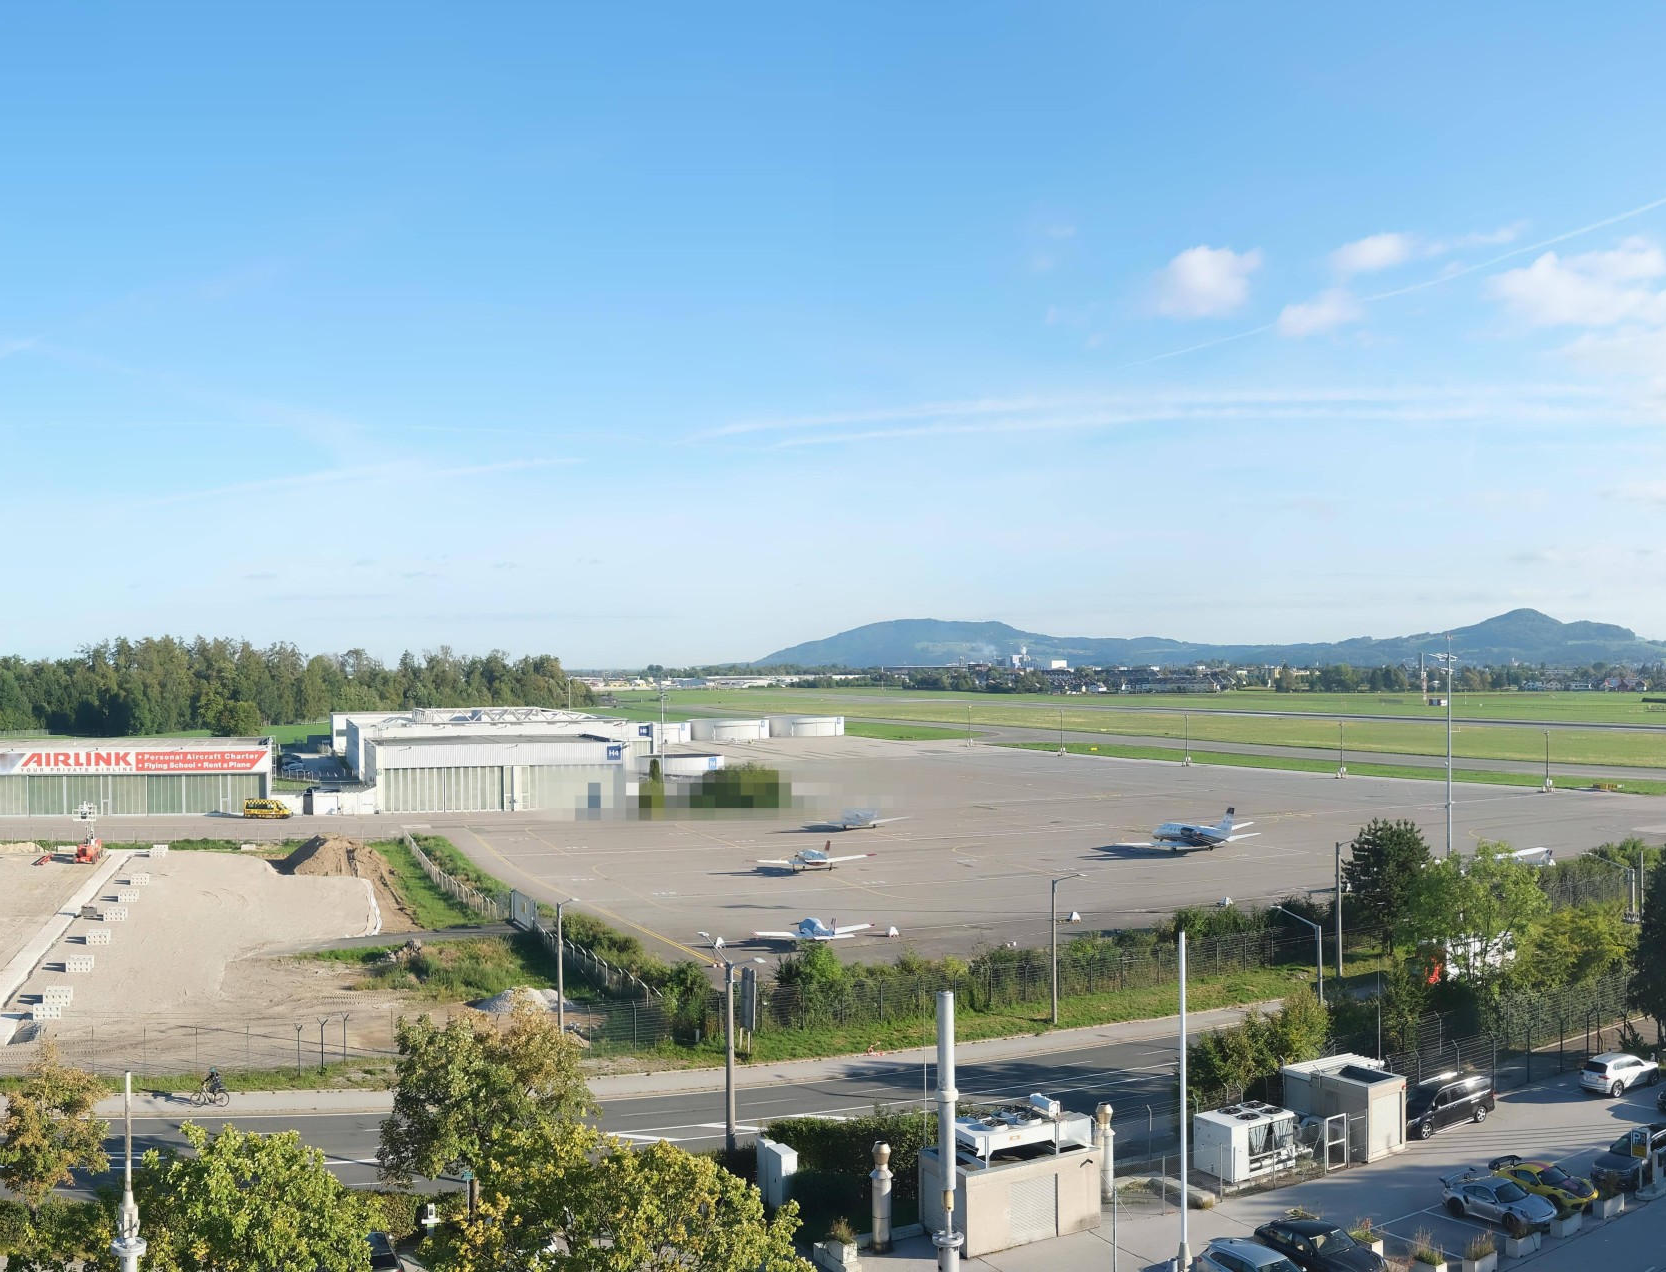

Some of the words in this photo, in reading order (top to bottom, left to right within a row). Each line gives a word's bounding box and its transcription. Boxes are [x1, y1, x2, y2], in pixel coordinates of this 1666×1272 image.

[144, 753, 183, 761] Personal
[186, 752, 222, 760] Aircraft
[224, 752, 259, 760] Charter
[608, 749, 620, 757] H4
[21, 752, 133, 767] AIRLINK
[1633, 1132, 1641, 1144] P
